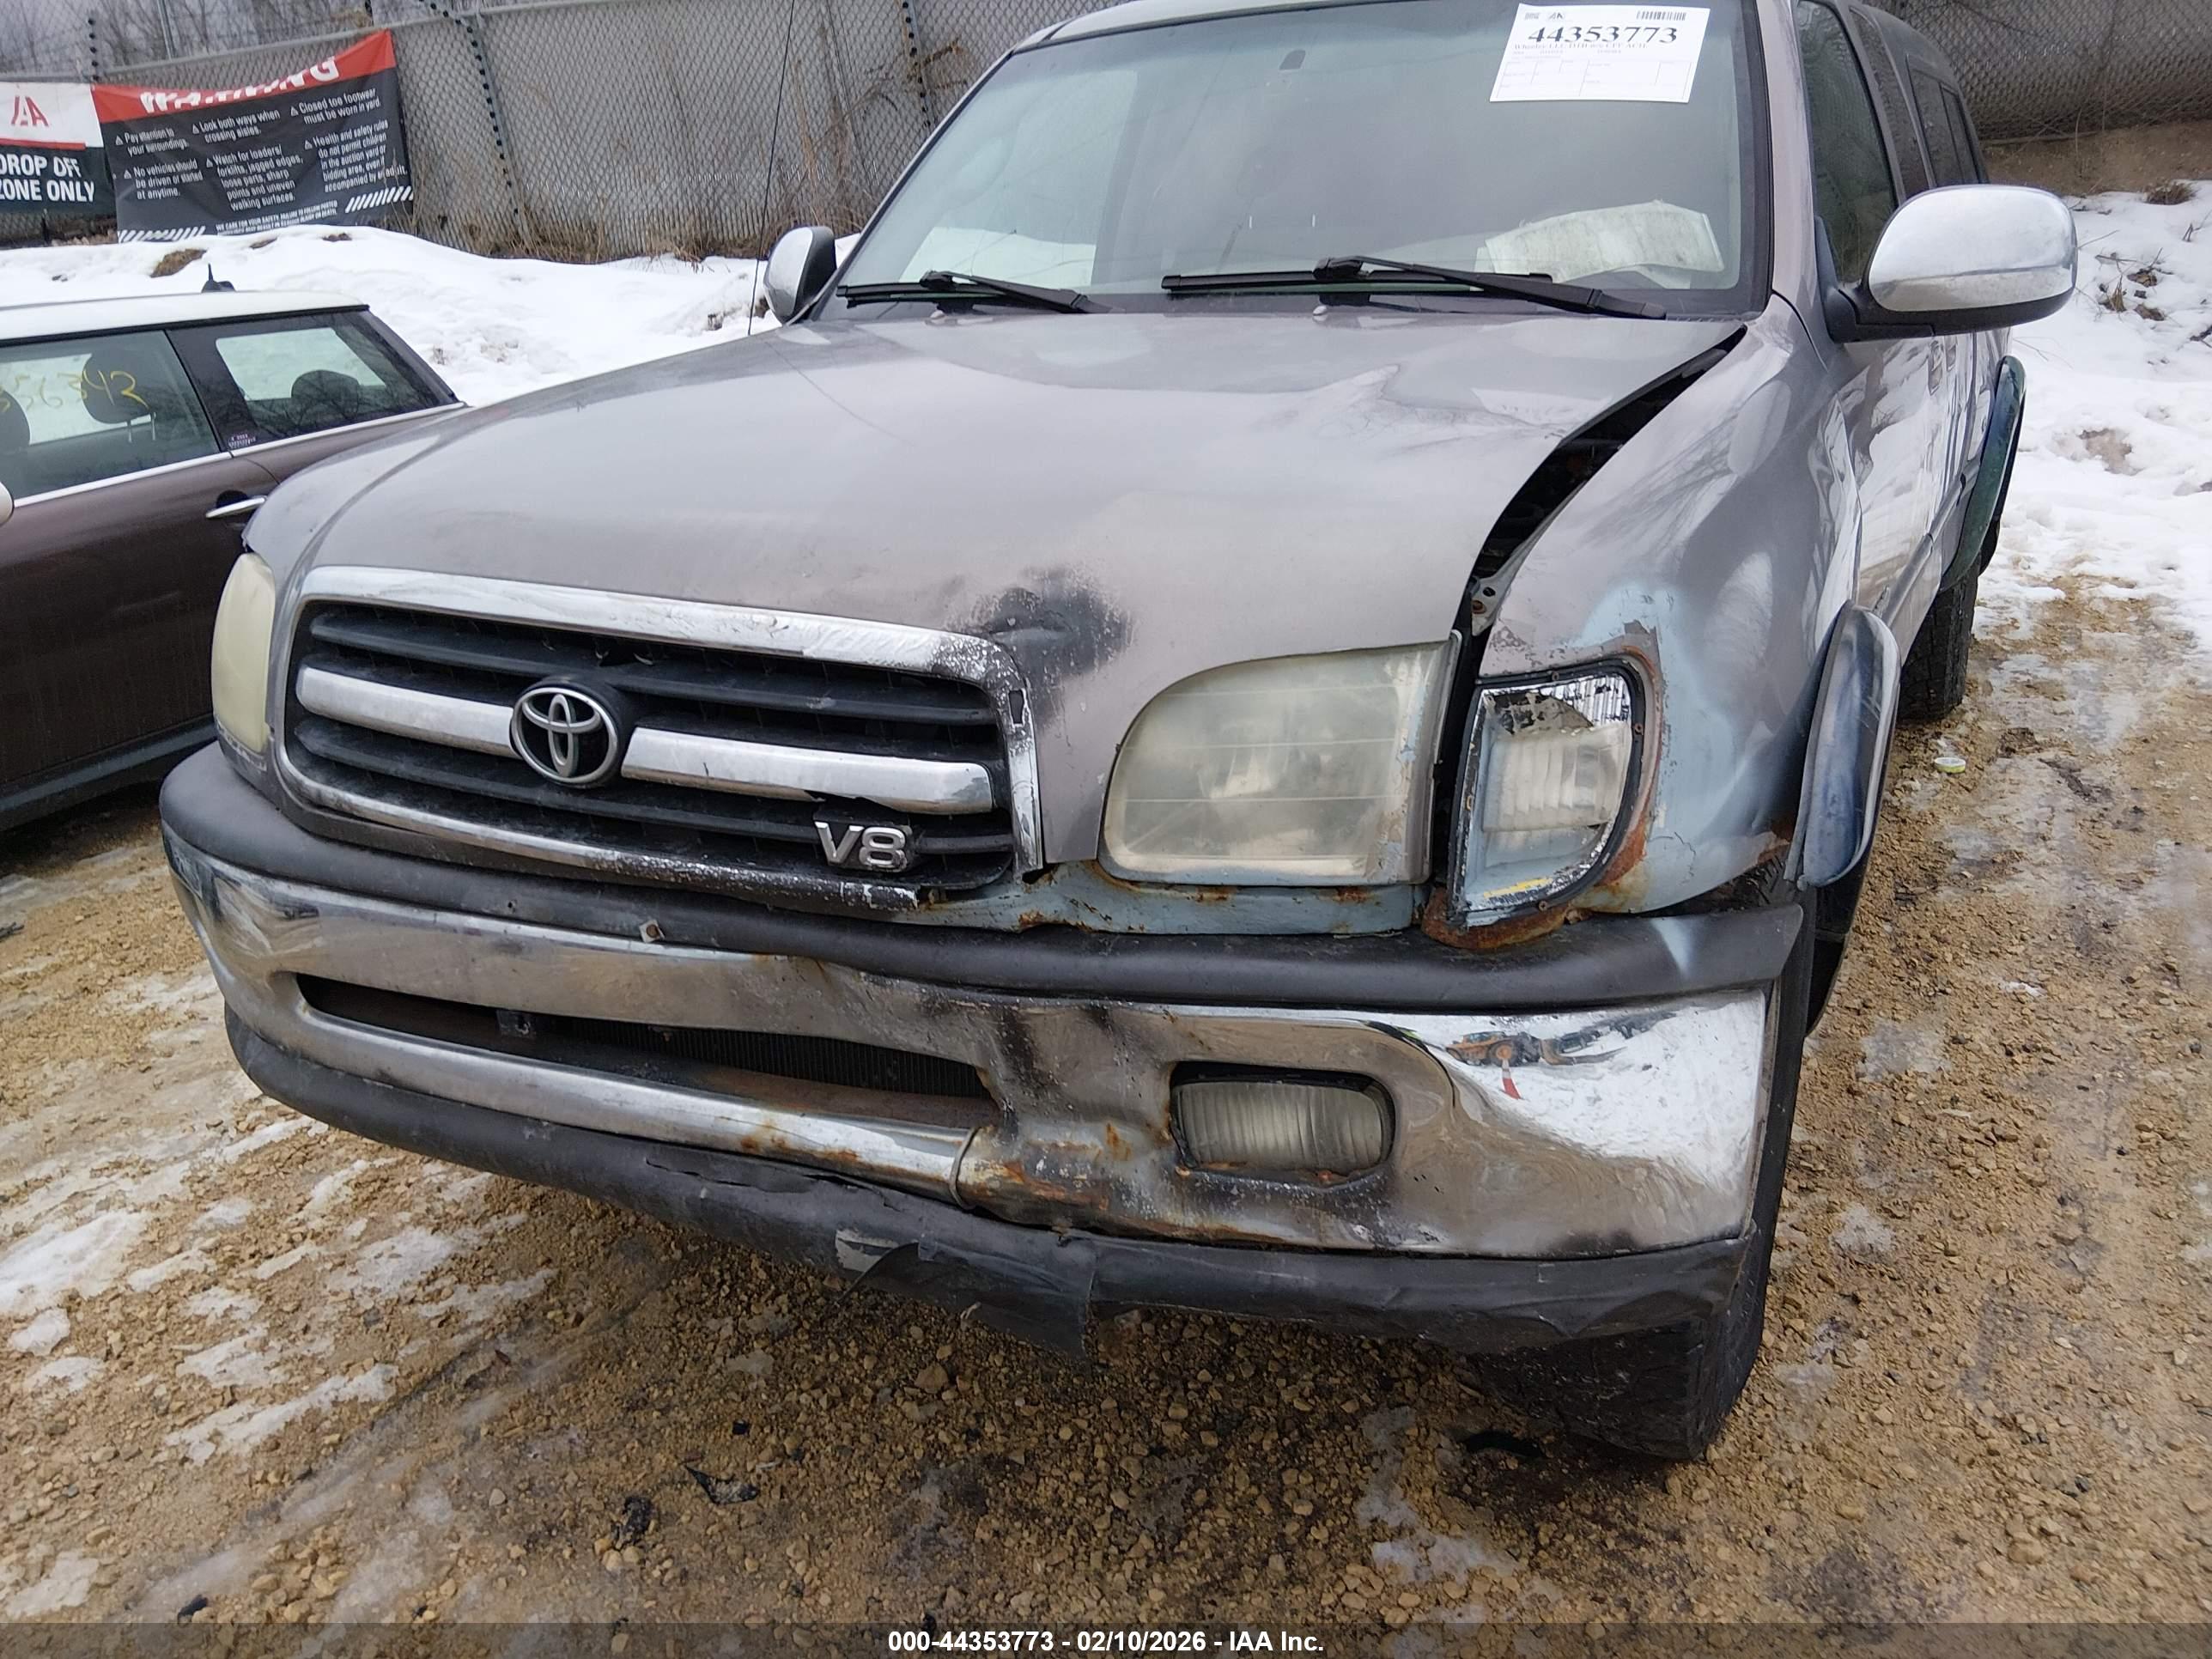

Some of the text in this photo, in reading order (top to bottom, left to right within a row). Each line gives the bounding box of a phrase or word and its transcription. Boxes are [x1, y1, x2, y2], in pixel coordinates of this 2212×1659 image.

[1528, 26, 1677, 43] 44353773
[299, 98, 328, 114] Closed
[343, 88, 376, 103] footwear
[199, 110, 281, 133] Look both ways when
[304, 112, 325, 125] must
[325, 110, 337, 120] be
[337, 105, 358, 117] worn
[359, 102, 365, 112] in
[125, 132, 138, 144] Pay
[313, 132, 339, 147] Health
[340, 128, 352, 141] and
[319, 132, 386, 159] do not permit children
[128, 145, 144, 158] your
[213, 153, 238, 165] Watch
[238, 151, 249, 161] for
[321, 161, 328, 170] in
[328, 157, 340, 167] the
[341, 151, 364, 166] auction
[365, 147, 379, 161] yard
[52, 155, 82, 178] OFF
[134, 167, 146, 178] No
[323, 168, 347, 182] bidding
[46, 179, 94, 202] ONLY
[136, 179, 146, 189] be
[148, 175, 171, 188] driven
[173, 174, 179, 185] or
[251, 184, 266, 196] and
[266, 179, 295, 193] uneven
[325, 174, 368, 193] accompanied
[369, 172, 376, 184] by
[137, 191, 146, 200] at
[231, 198, 261, 212] walking
[815, 821, 908, 872] V8
